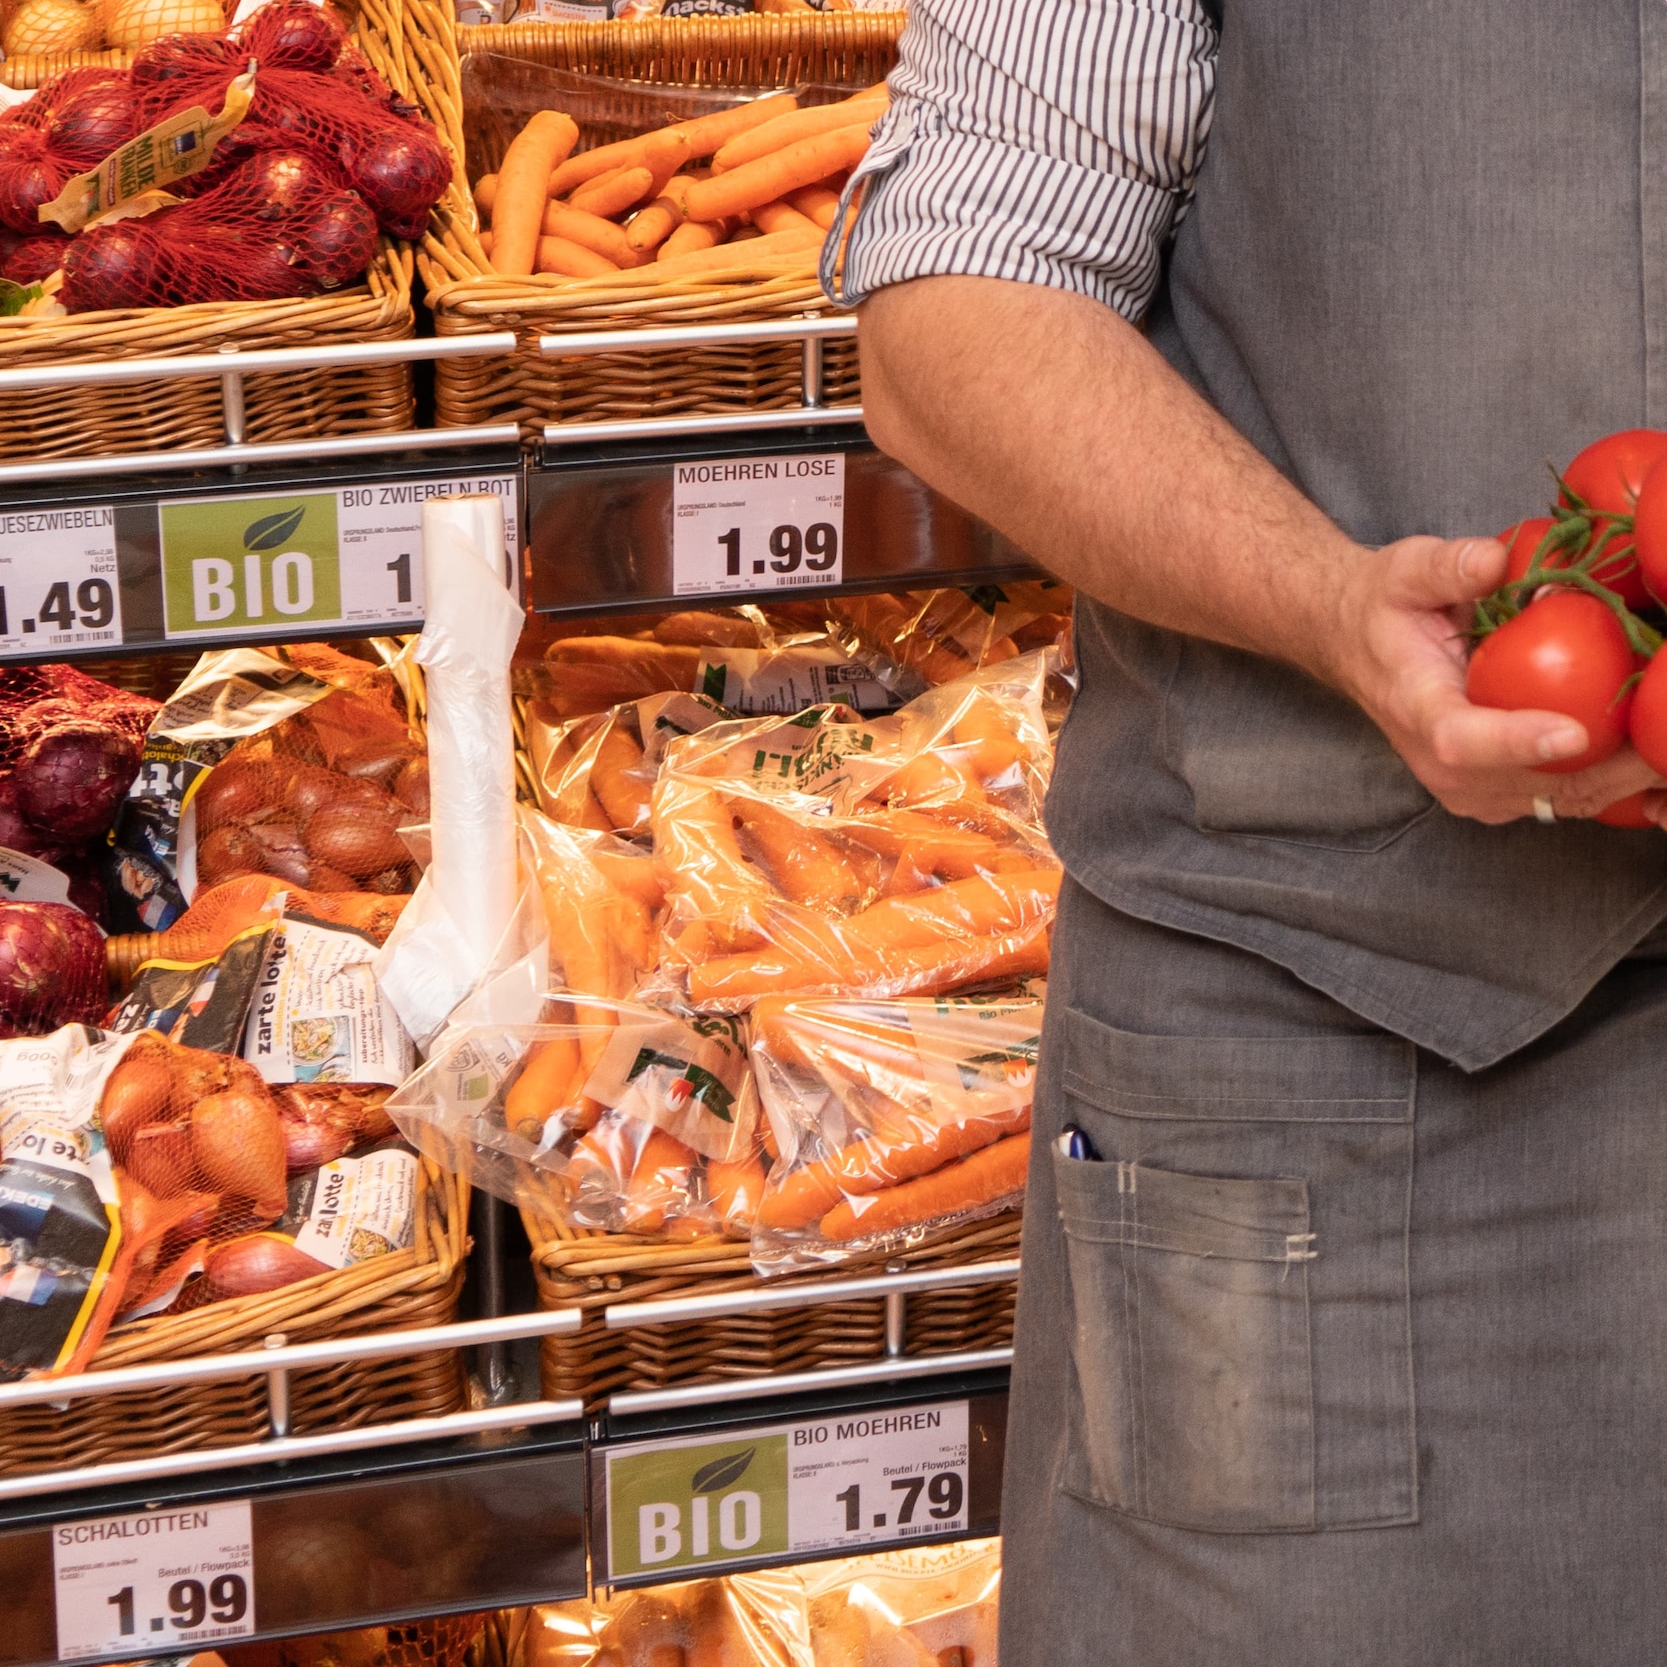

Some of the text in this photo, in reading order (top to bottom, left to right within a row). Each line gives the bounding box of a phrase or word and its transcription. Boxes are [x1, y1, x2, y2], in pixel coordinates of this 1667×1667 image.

[679, 460, 835, 484] MOEHREN LOSE
[343, 489, 372, 508] BIO
[717, 522, 838, 576] 1.99
[91, 564, 115, 573] Netz
[192, 552, 314, 622] BIO
[257, 934, 288, 1055] zarte lotte
[793, 1411, 941, 1446] BIO MOEHREN
[883, 1465, 913, 1476] Beutel
[922, 1458, 967, 1471] Flowpack
[836, 1472, 963, 1532] 1.79
[58, 1511, 209, 1546] SCHALOTTEN
[638, 1490, 761, 1565] BIO
[158, 1567, 191, 1578] Beutel
[201, 1559, 249, 1573] Flowpack
[107, 1574, 247, 1636] 1.99
